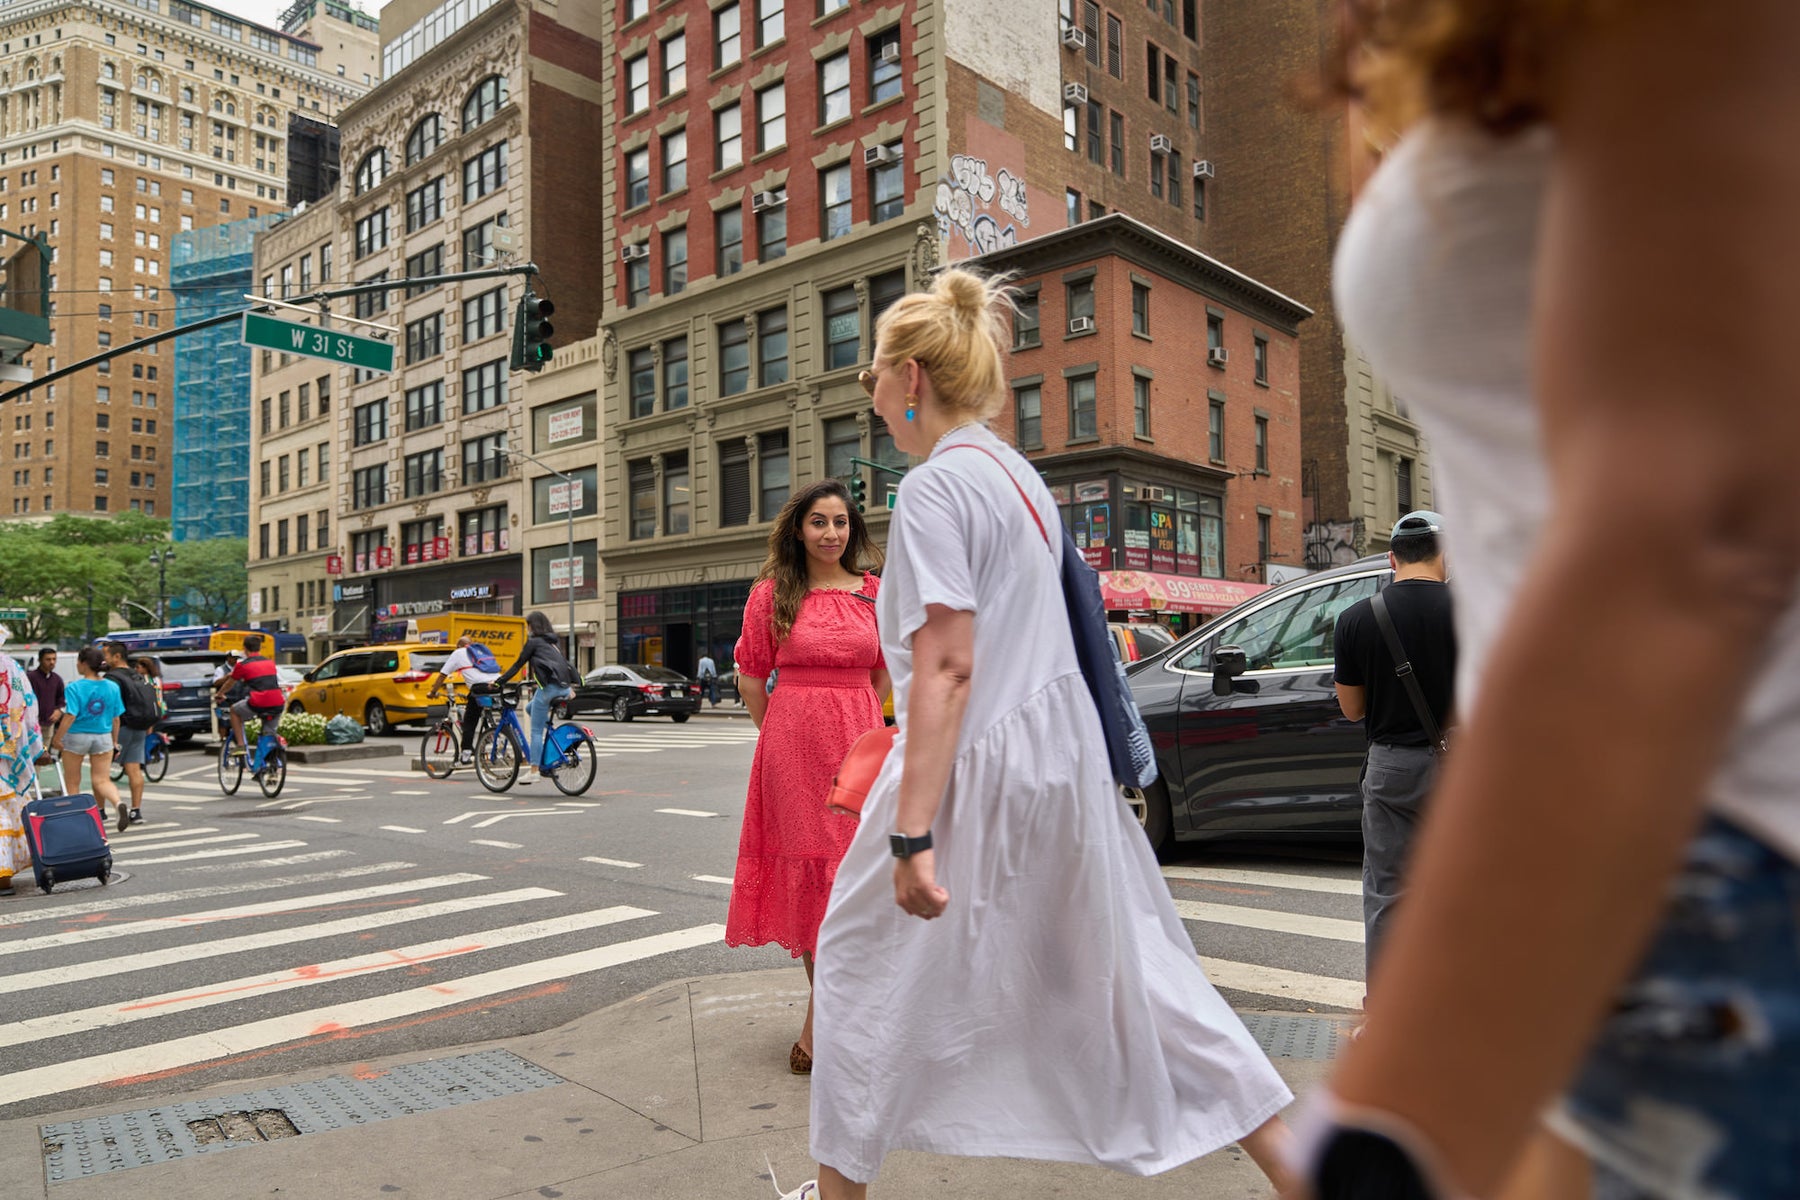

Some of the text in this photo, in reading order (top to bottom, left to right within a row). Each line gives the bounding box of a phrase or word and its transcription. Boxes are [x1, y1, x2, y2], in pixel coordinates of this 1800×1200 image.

[291, 328, 355, 359] W 31 St
[1152, 512, 1173, 528] SPA
[1159, 539, 1174, 550] PEDI
[1167, 580, 1191, 598] 99
[1190, 582, 1216, 594] CENTS
[1192, 591, 1215, 601] FRESH
[1215, 593, 1234, 602] PIZZA
[463, 629, 515, 640] PENSKE
